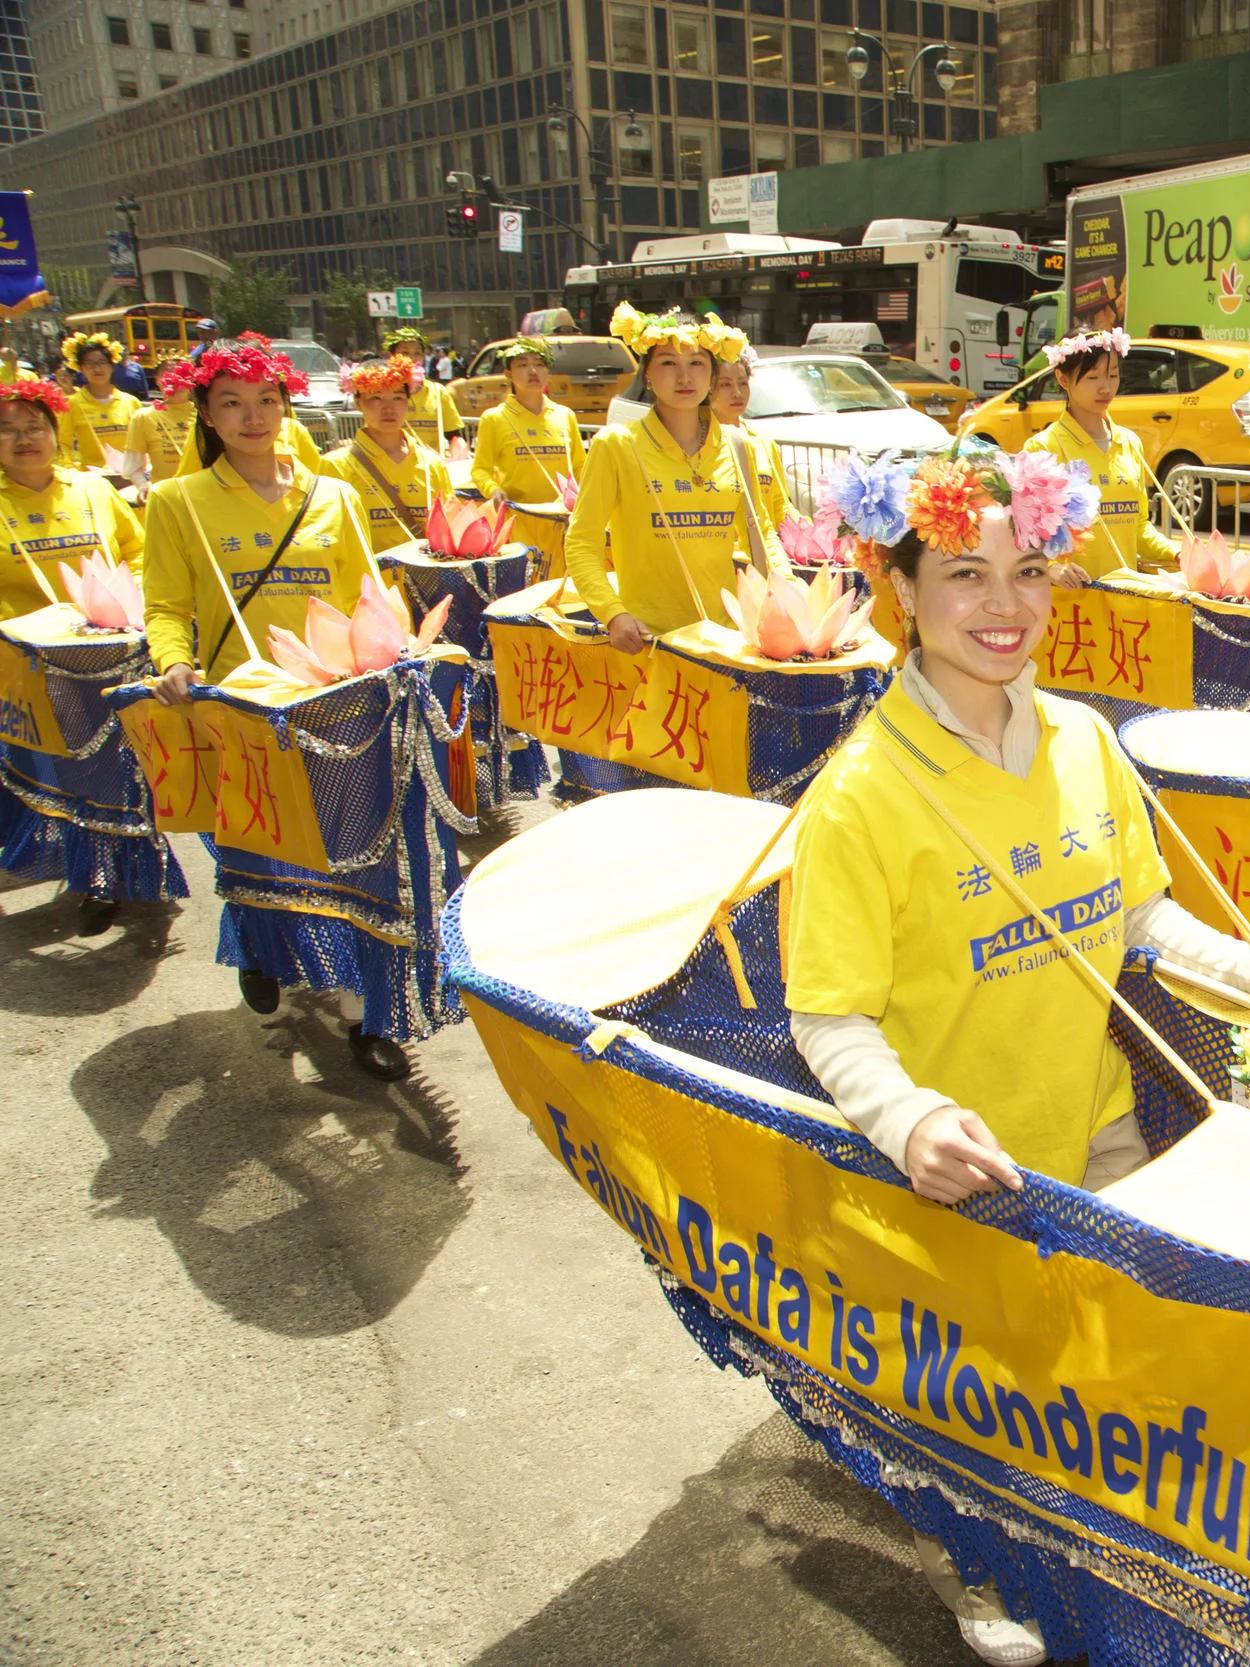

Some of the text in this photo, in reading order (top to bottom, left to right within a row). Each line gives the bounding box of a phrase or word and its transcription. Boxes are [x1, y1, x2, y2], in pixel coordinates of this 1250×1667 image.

[798, 255, 814, 265] DAY
[1012, 251, 1036, 263] 3927
[1207, 288, 1216, 304] by
[1234, 326, 1246, 340] to
[290, 568, 327, 583] DAFA
[1072, 883, 1122, 926] DAFA
[545, 1101, 674, 1266] Falun
[677, 1193, 811, 1352] Dafa
[825, 1270, 880, 1387] is
